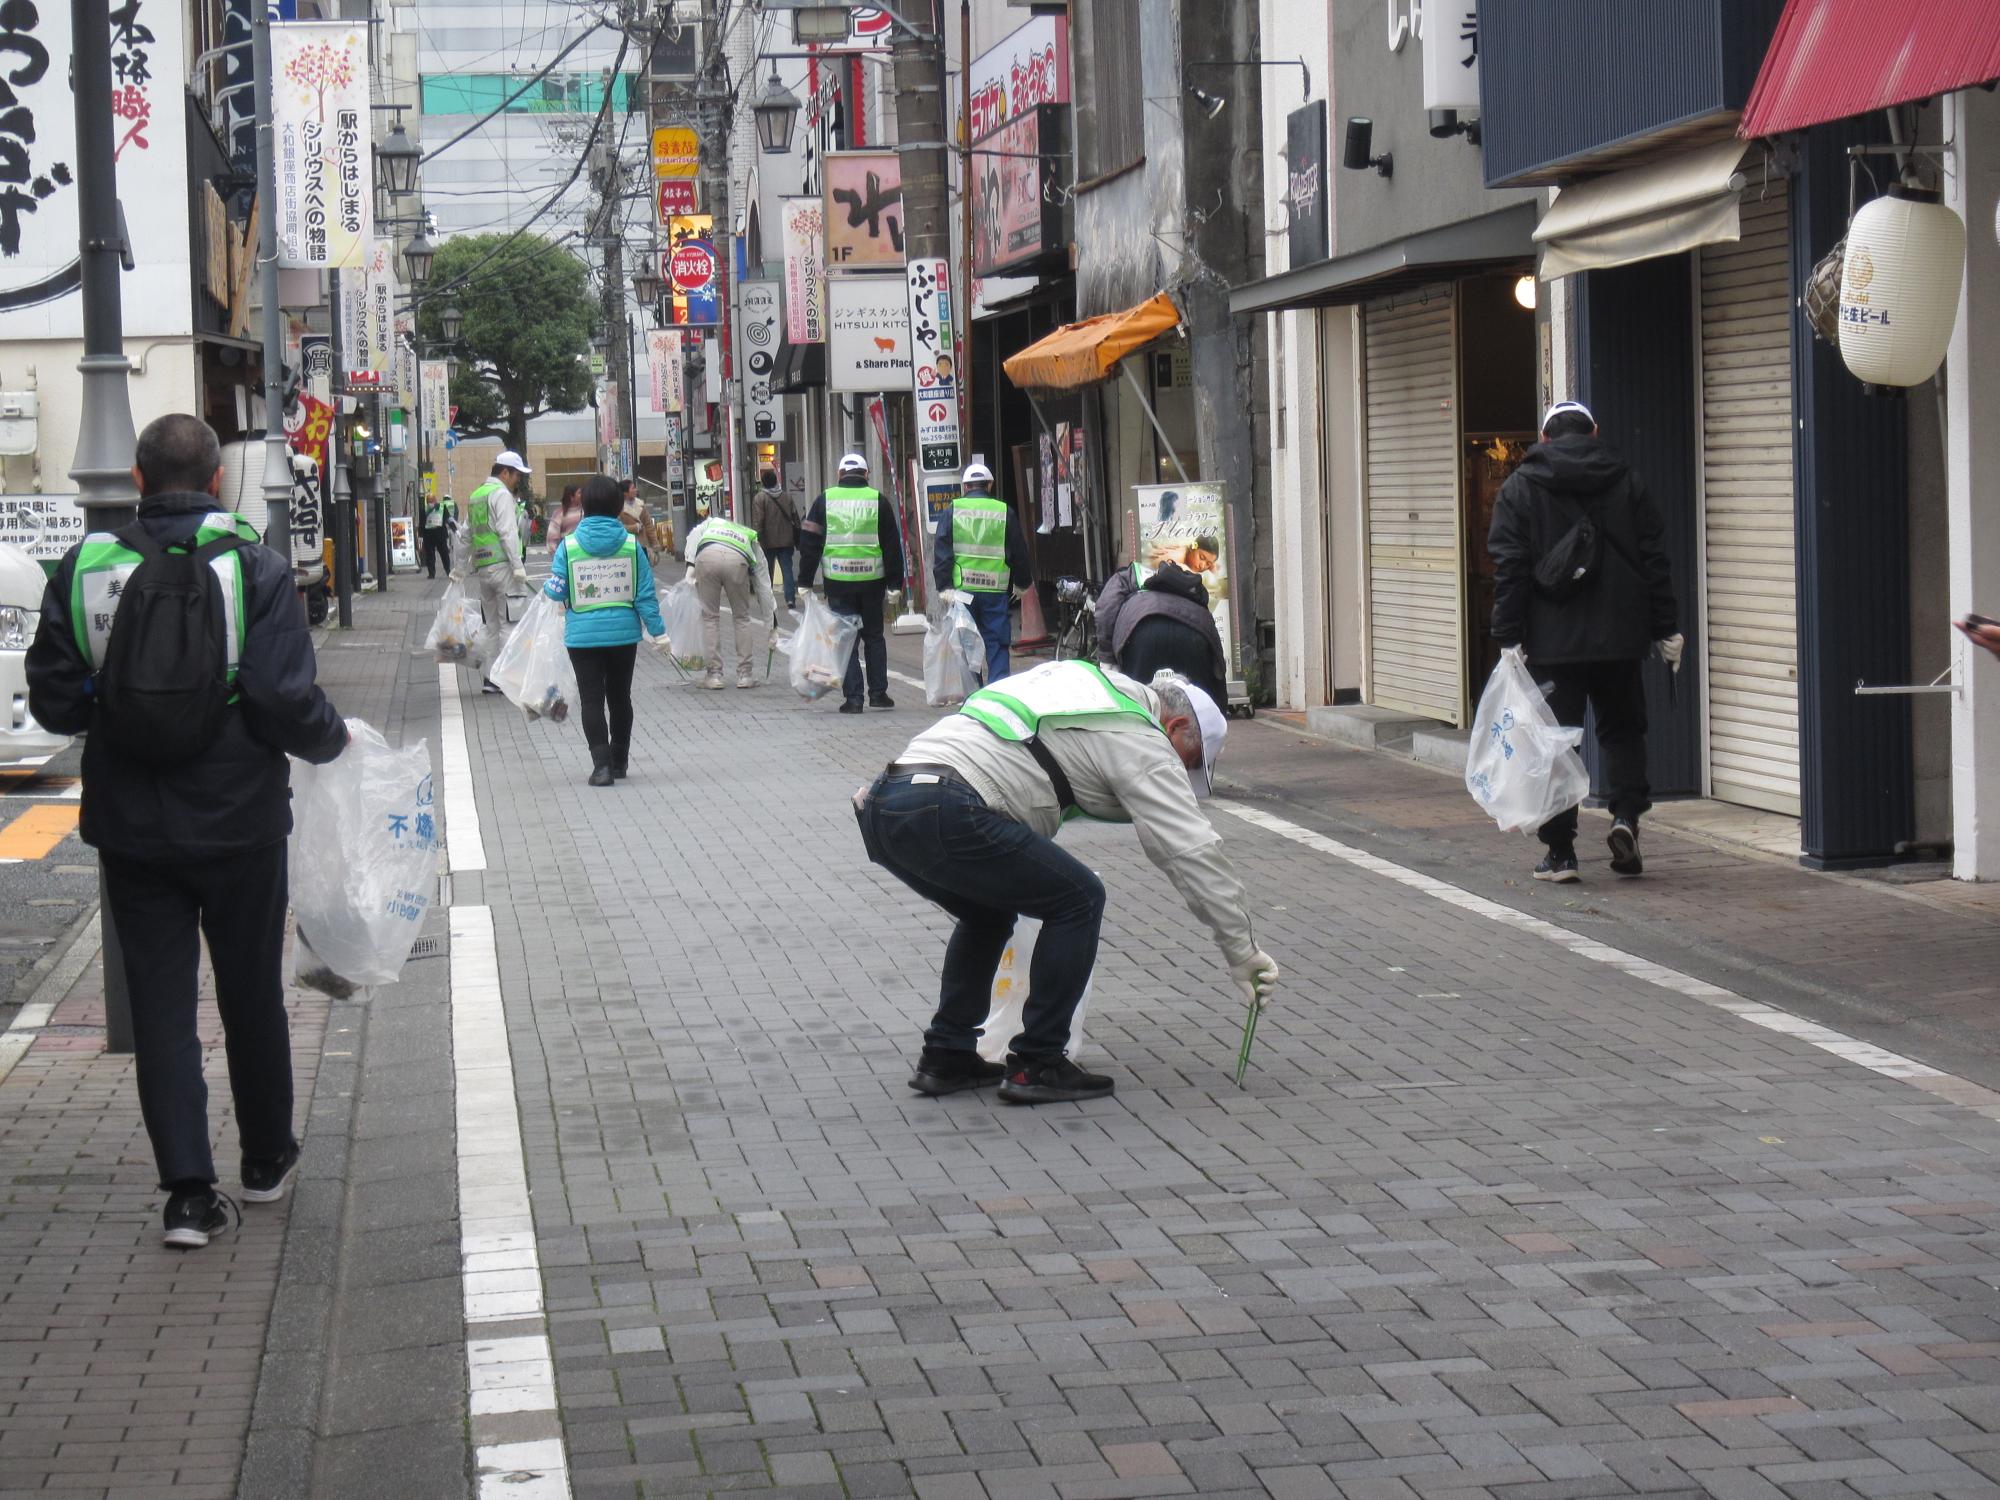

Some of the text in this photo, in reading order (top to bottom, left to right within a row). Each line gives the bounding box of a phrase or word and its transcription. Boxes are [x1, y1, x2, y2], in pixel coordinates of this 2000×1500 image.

[340, 110, 361, 233] 駅からはじまる
[282, 121, 298, 260] 大和銀座商店街協同組合
[305, 122, 327, 261] シリウスへの物語
[832, 246, 853, 262] 1F
[674, 259, 709, 276] 消火栓
[803, 256, 819, 339] シリウスへの物語
[911, 264, 937, 351] ふじや
[376, 285, 387, 352] 駅からはじまる
[835, 321, 878, 330] HITSUJI
[357, 290, 369, 368] シリウスへの物語
[311, 349, 328, 371] 質
[856, 361, 862, 369] &
[864, 359, 888, 369] Share
[929, 448, 952, 457] 大和南
[933, 459, 950, 467] 1-2
[0, 517, 82, 530] 用場あり
[1146, 520, 1219, 540] Flower
[578, 563, 628, 573] クリーンキャンペーン
[94, 613, 112, 631] 駅
